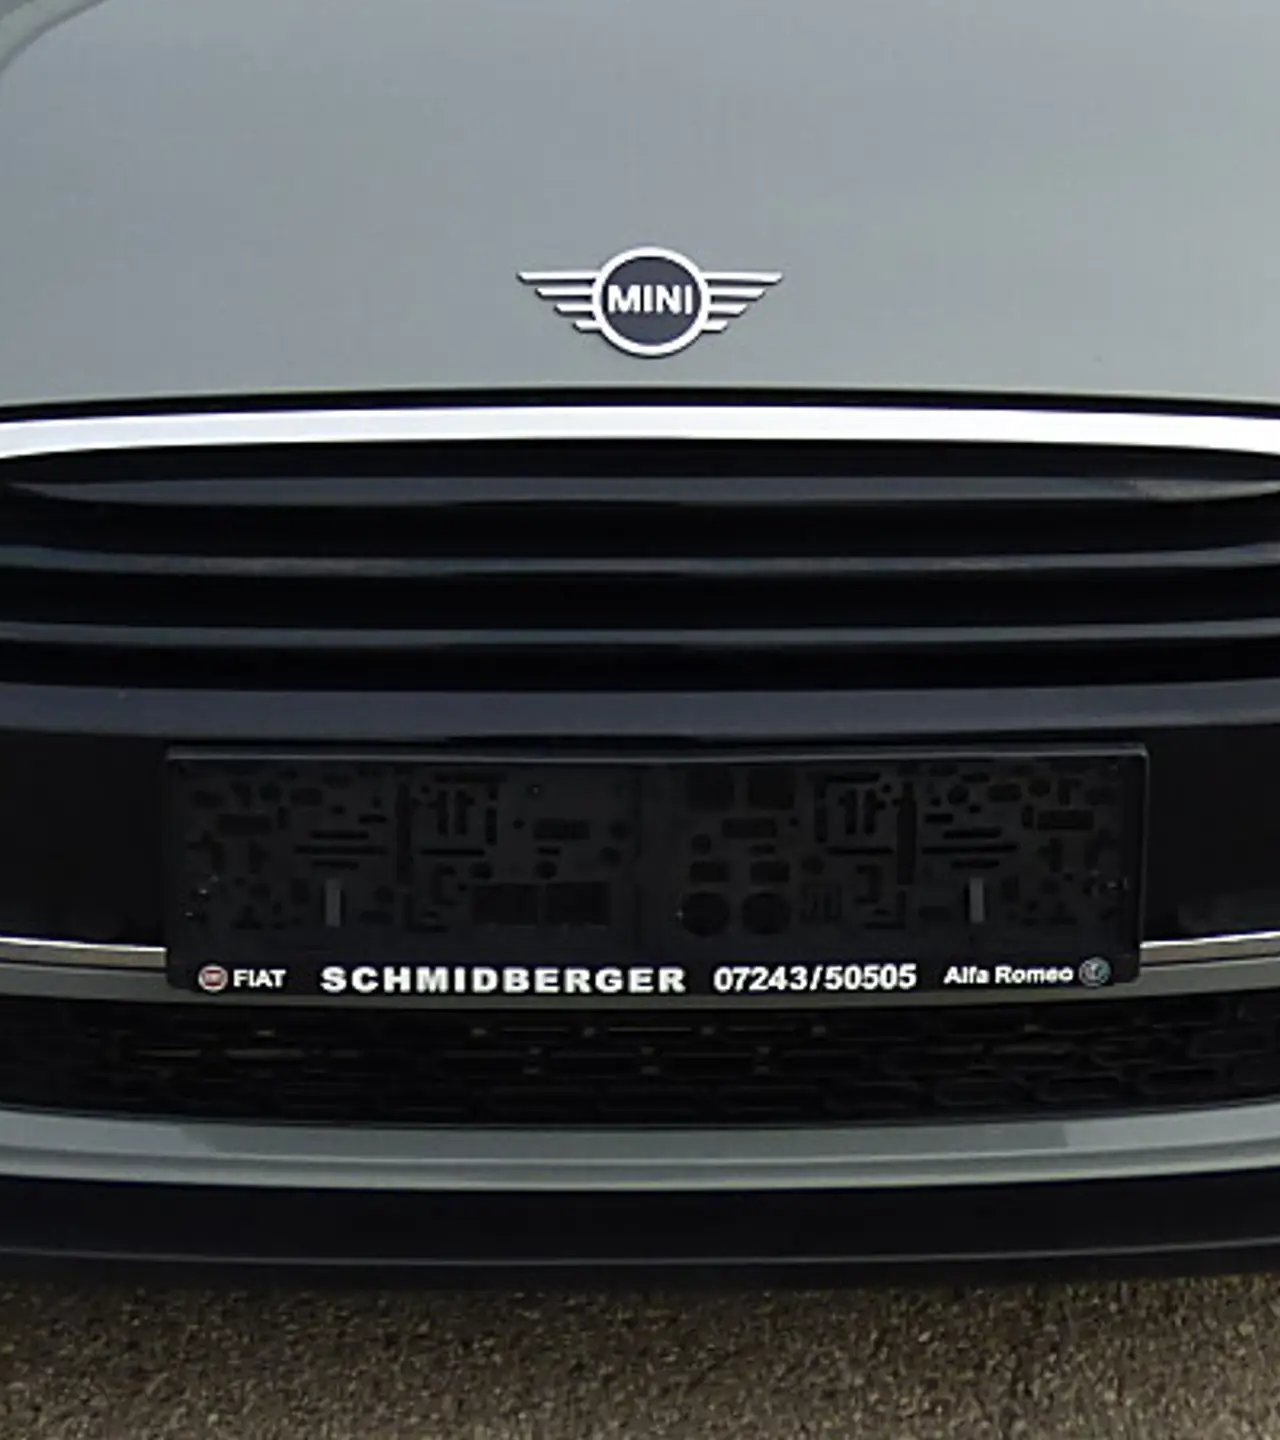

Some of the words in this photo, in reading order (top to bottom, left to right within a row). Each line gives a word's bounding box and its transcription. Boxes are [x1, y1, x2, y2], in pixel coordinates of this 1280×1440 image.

[607, 284, 694, 316] MINI
[232, 968, 287, 989] FIAT
[320, 966, 686, 994] SCHMIDBERGER
[713, 964, 917, 992] 07243/50505
[943, 965, 989, 985] Alfa
[994, 966, 1074, 985] Romeo
